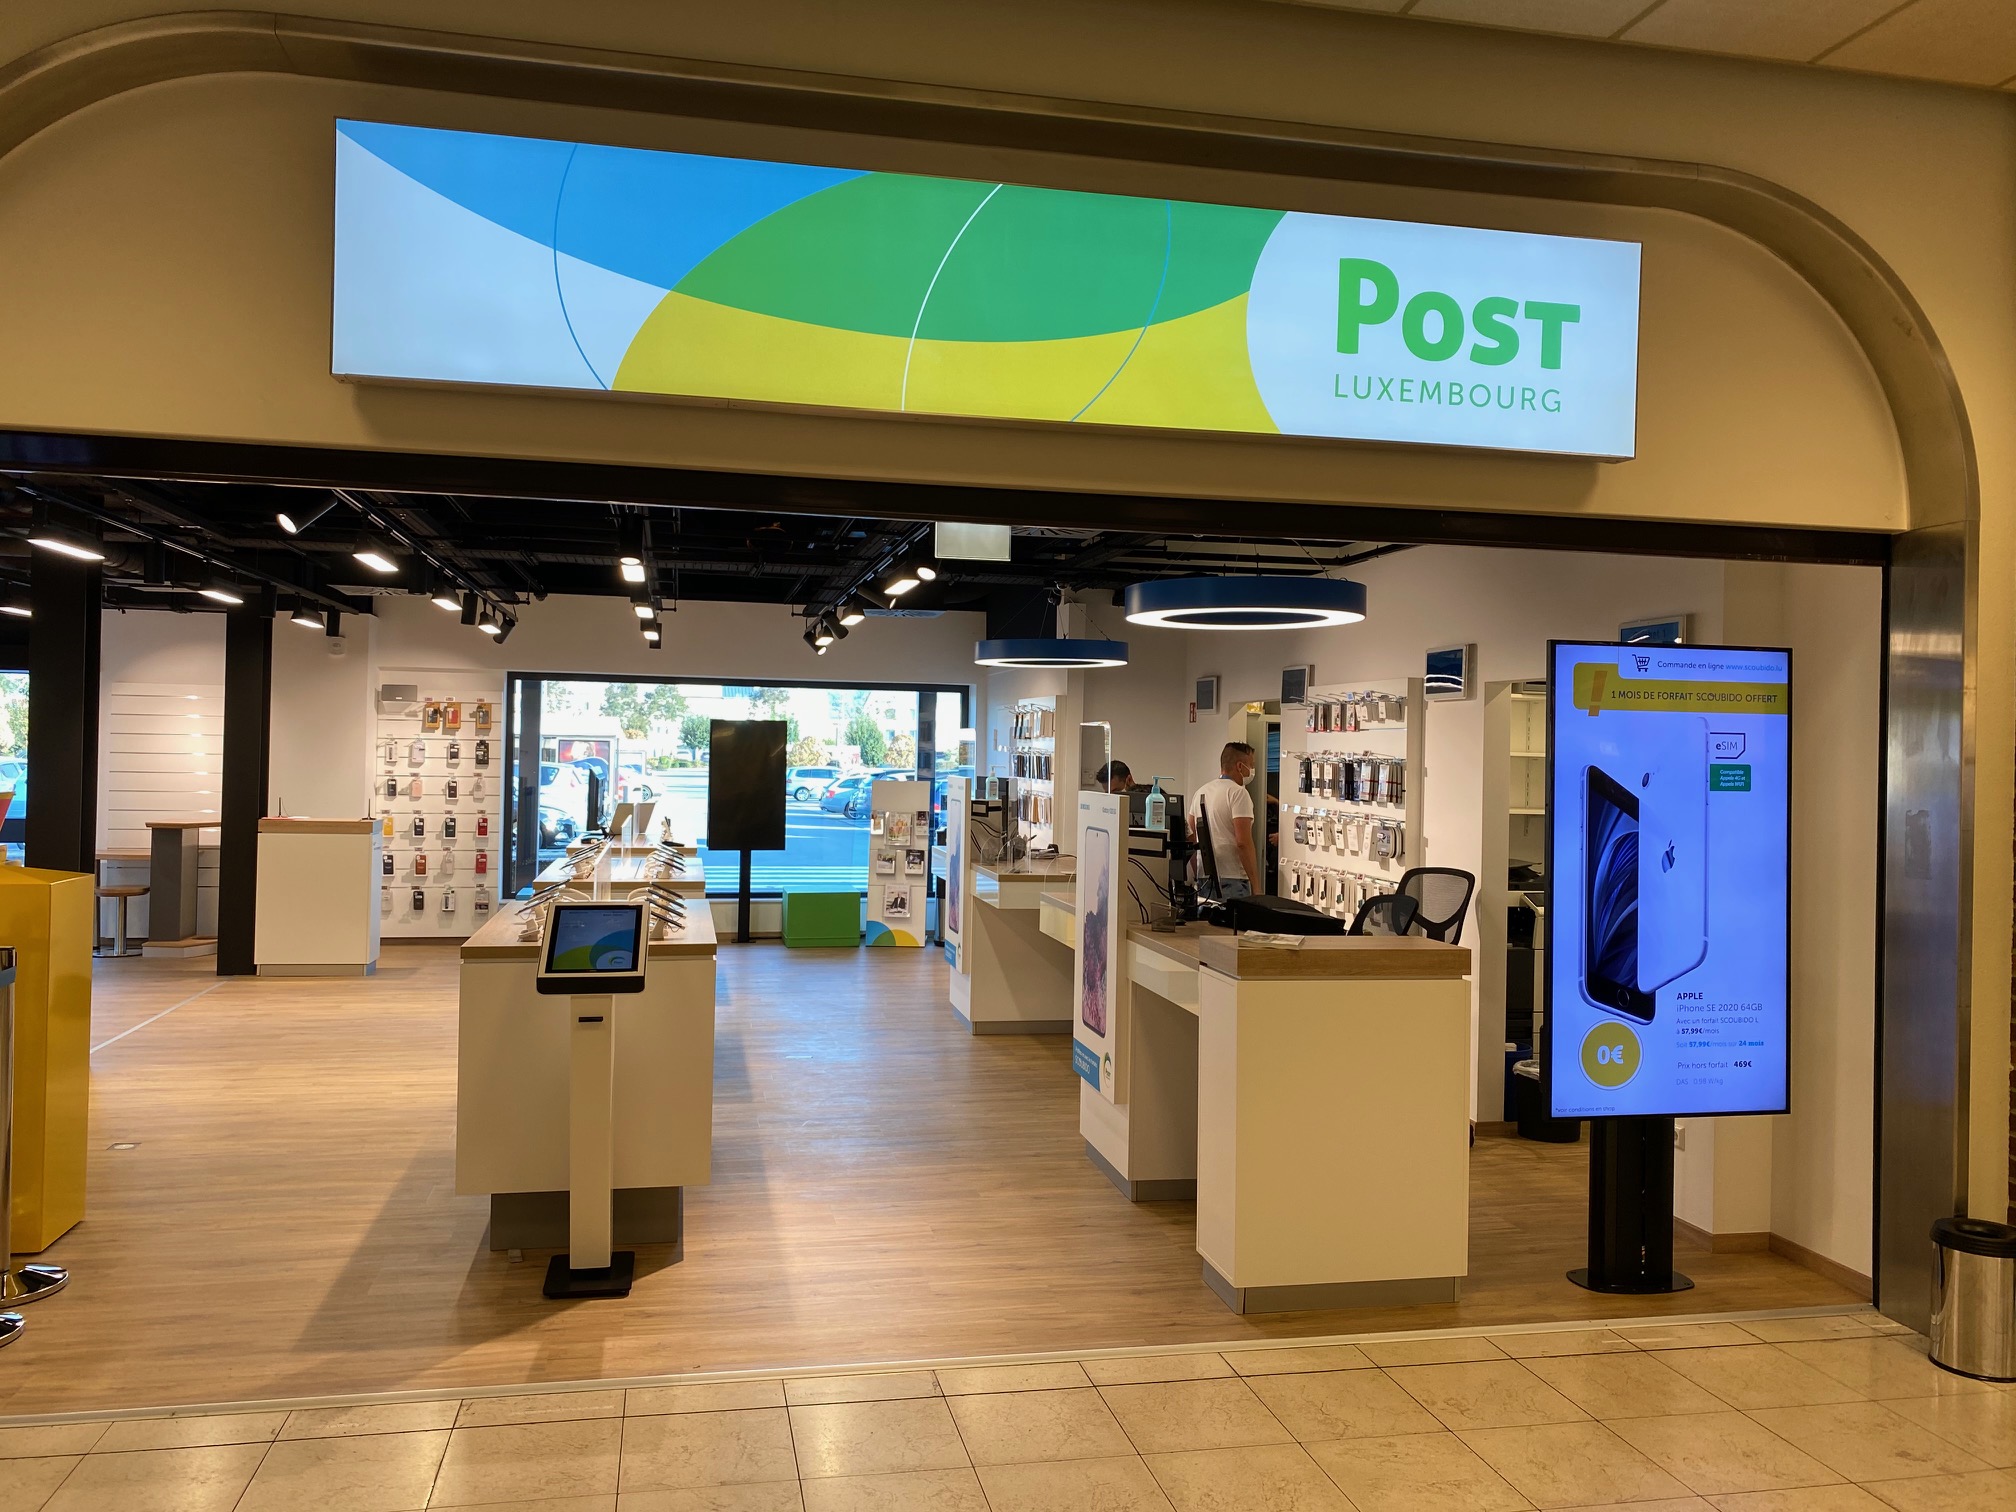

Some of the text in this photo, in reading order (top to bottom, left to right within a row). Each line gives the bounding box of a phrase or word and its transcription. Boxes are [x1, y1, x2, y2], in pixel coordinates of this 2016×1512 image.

[1336, 257, 1581, 370] POST
[1334, 373, 1561, 413] LUXEMBOURG
[1658, 660, 1697, 670] Commande
[1708, 662, 1724, 670] ligne
[1611, 691, 1778, 704] 1 MOIS DE FORFAIT SCOUBIDO OFFERT
[1716, 741, 1738, 750] eSIM
[1676, 992, 1704, 1000] APPLE
[1676, 1003, 1763, 1012] iPhone SE 2020 64GB
[1596, 1044, 1624, 1065] 0€
[1677, 1060, 1752, 1070] Prix hors forfait 469€
